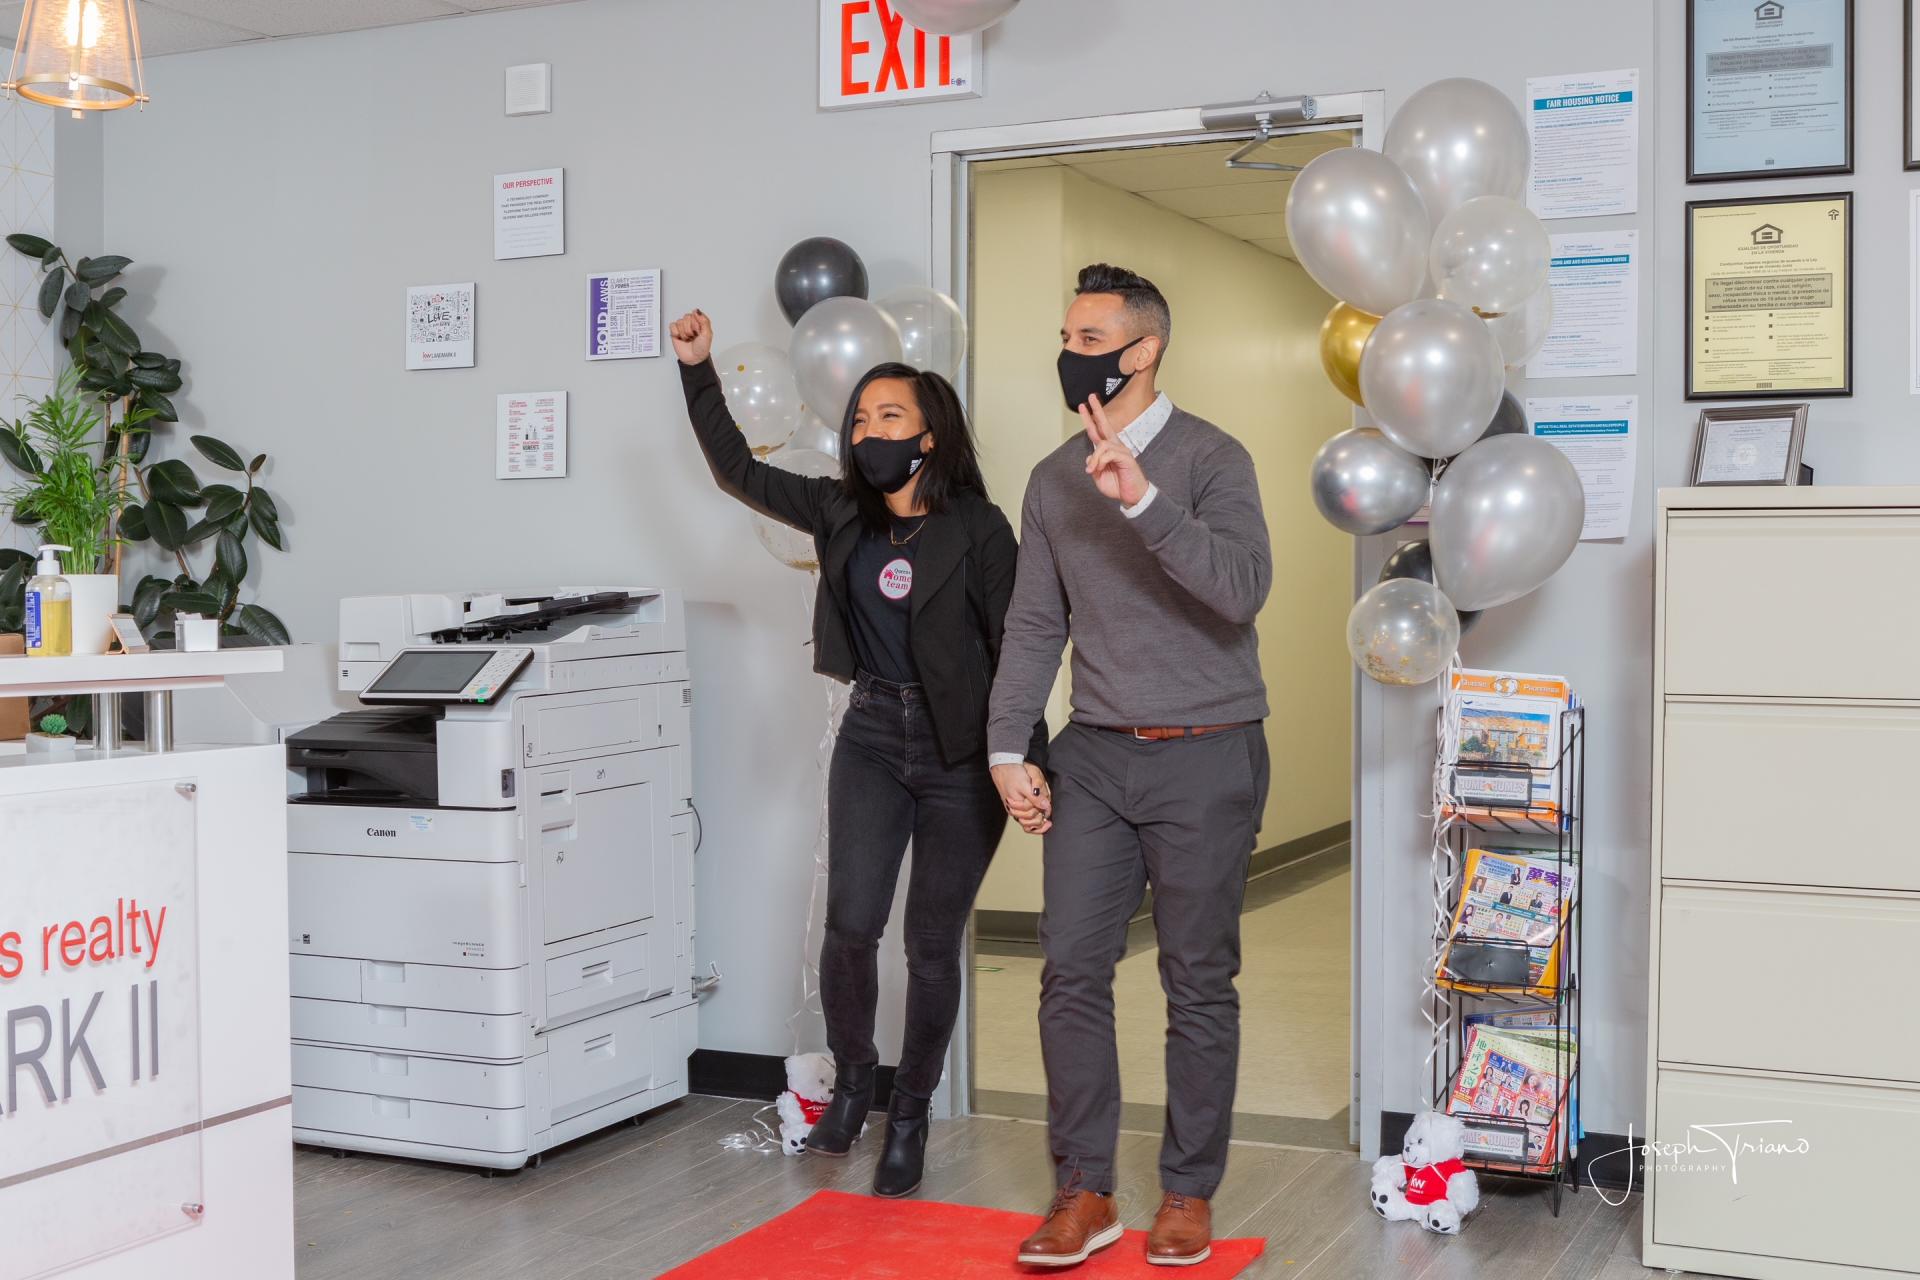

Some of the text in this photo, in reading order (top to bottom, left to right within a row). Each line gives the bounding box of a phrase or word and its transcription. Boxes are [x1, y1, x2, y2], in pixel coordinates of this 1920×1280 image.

[1546, 94, 1621, 109] FAIR HOUSING NOTICE
[516, 178, 553, 188] PERSPECTIVE
[427, 311, 450, 323] LOVE
[597, 279, 608, 354] BOLD LAWS
[886, 580, 909, 590] team
[366, 827, 397, 838] Canon
[42, 897, 167, 970] realty
[0, 980, 160, 1115] RK II
